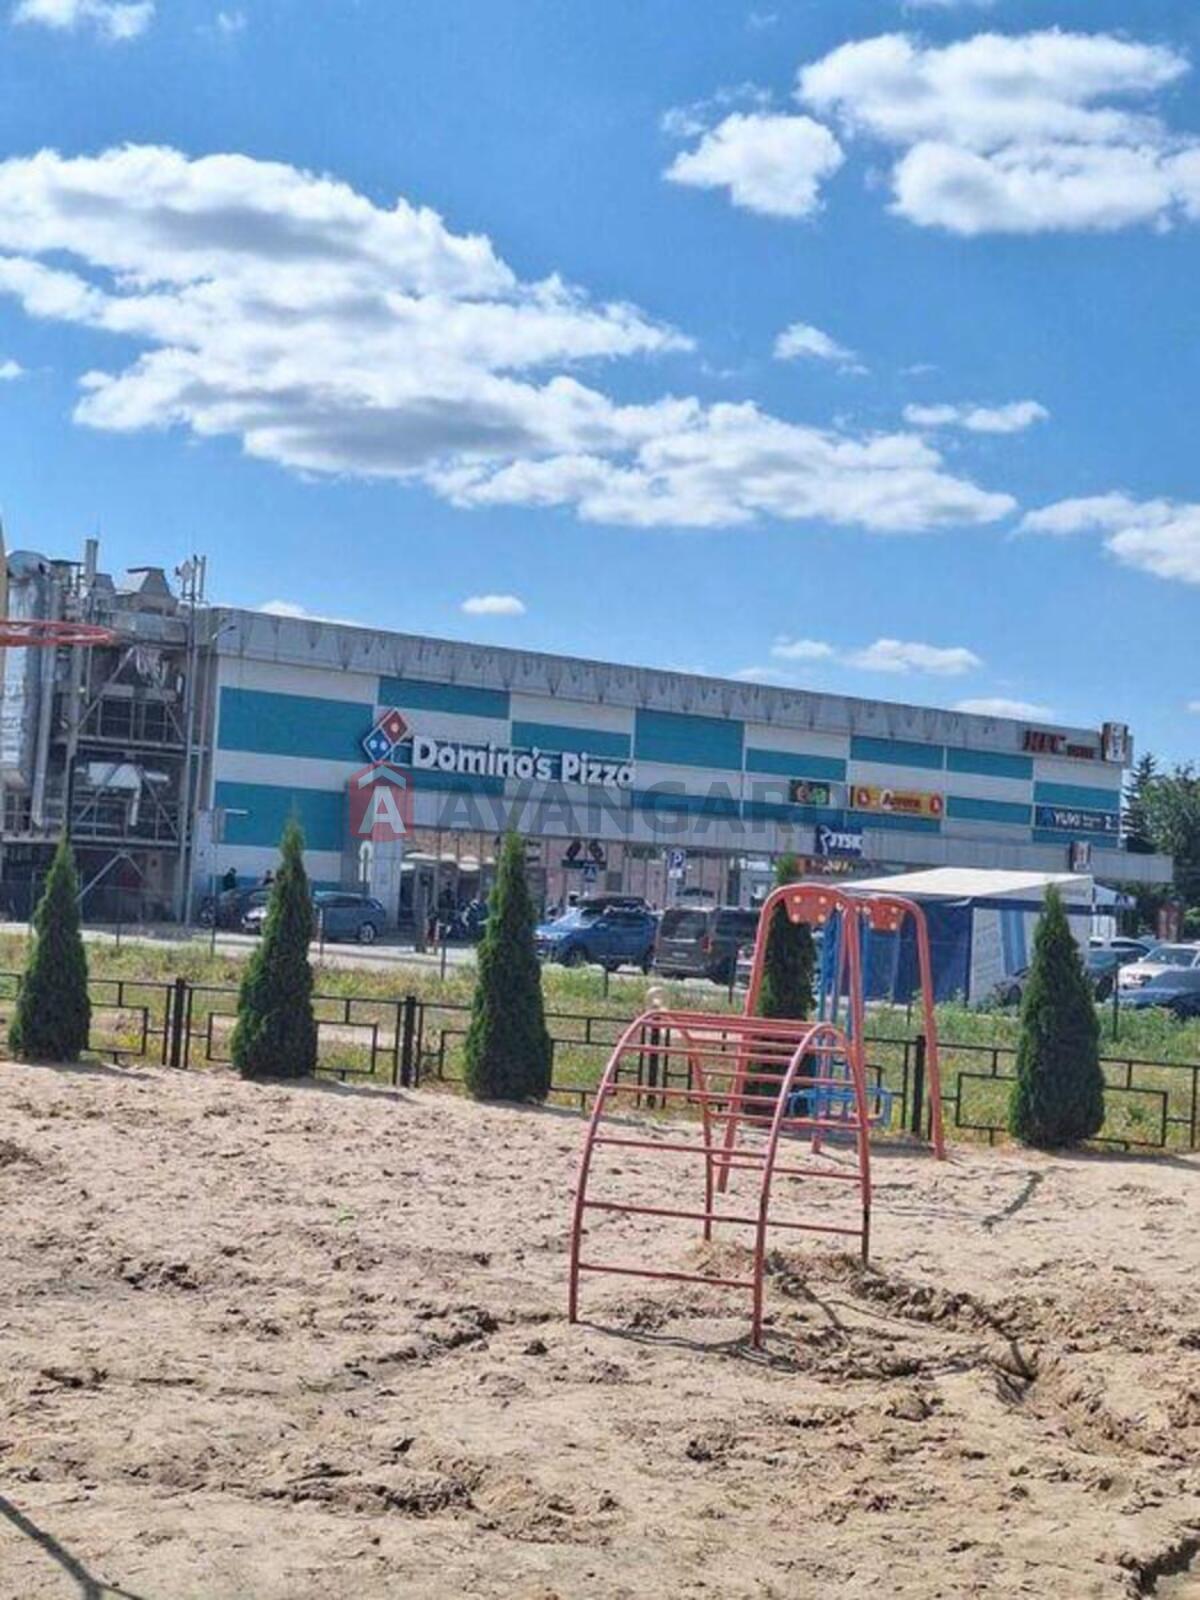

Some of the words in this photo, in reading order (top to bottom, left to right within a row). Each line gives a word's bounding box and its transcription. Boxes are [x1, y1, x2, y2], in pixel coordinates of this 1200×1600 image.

[411, 735, 552, 781] Domino's
[561, 751, 637, 787] Pizza
[829, 833, 863, 850] JYSK
